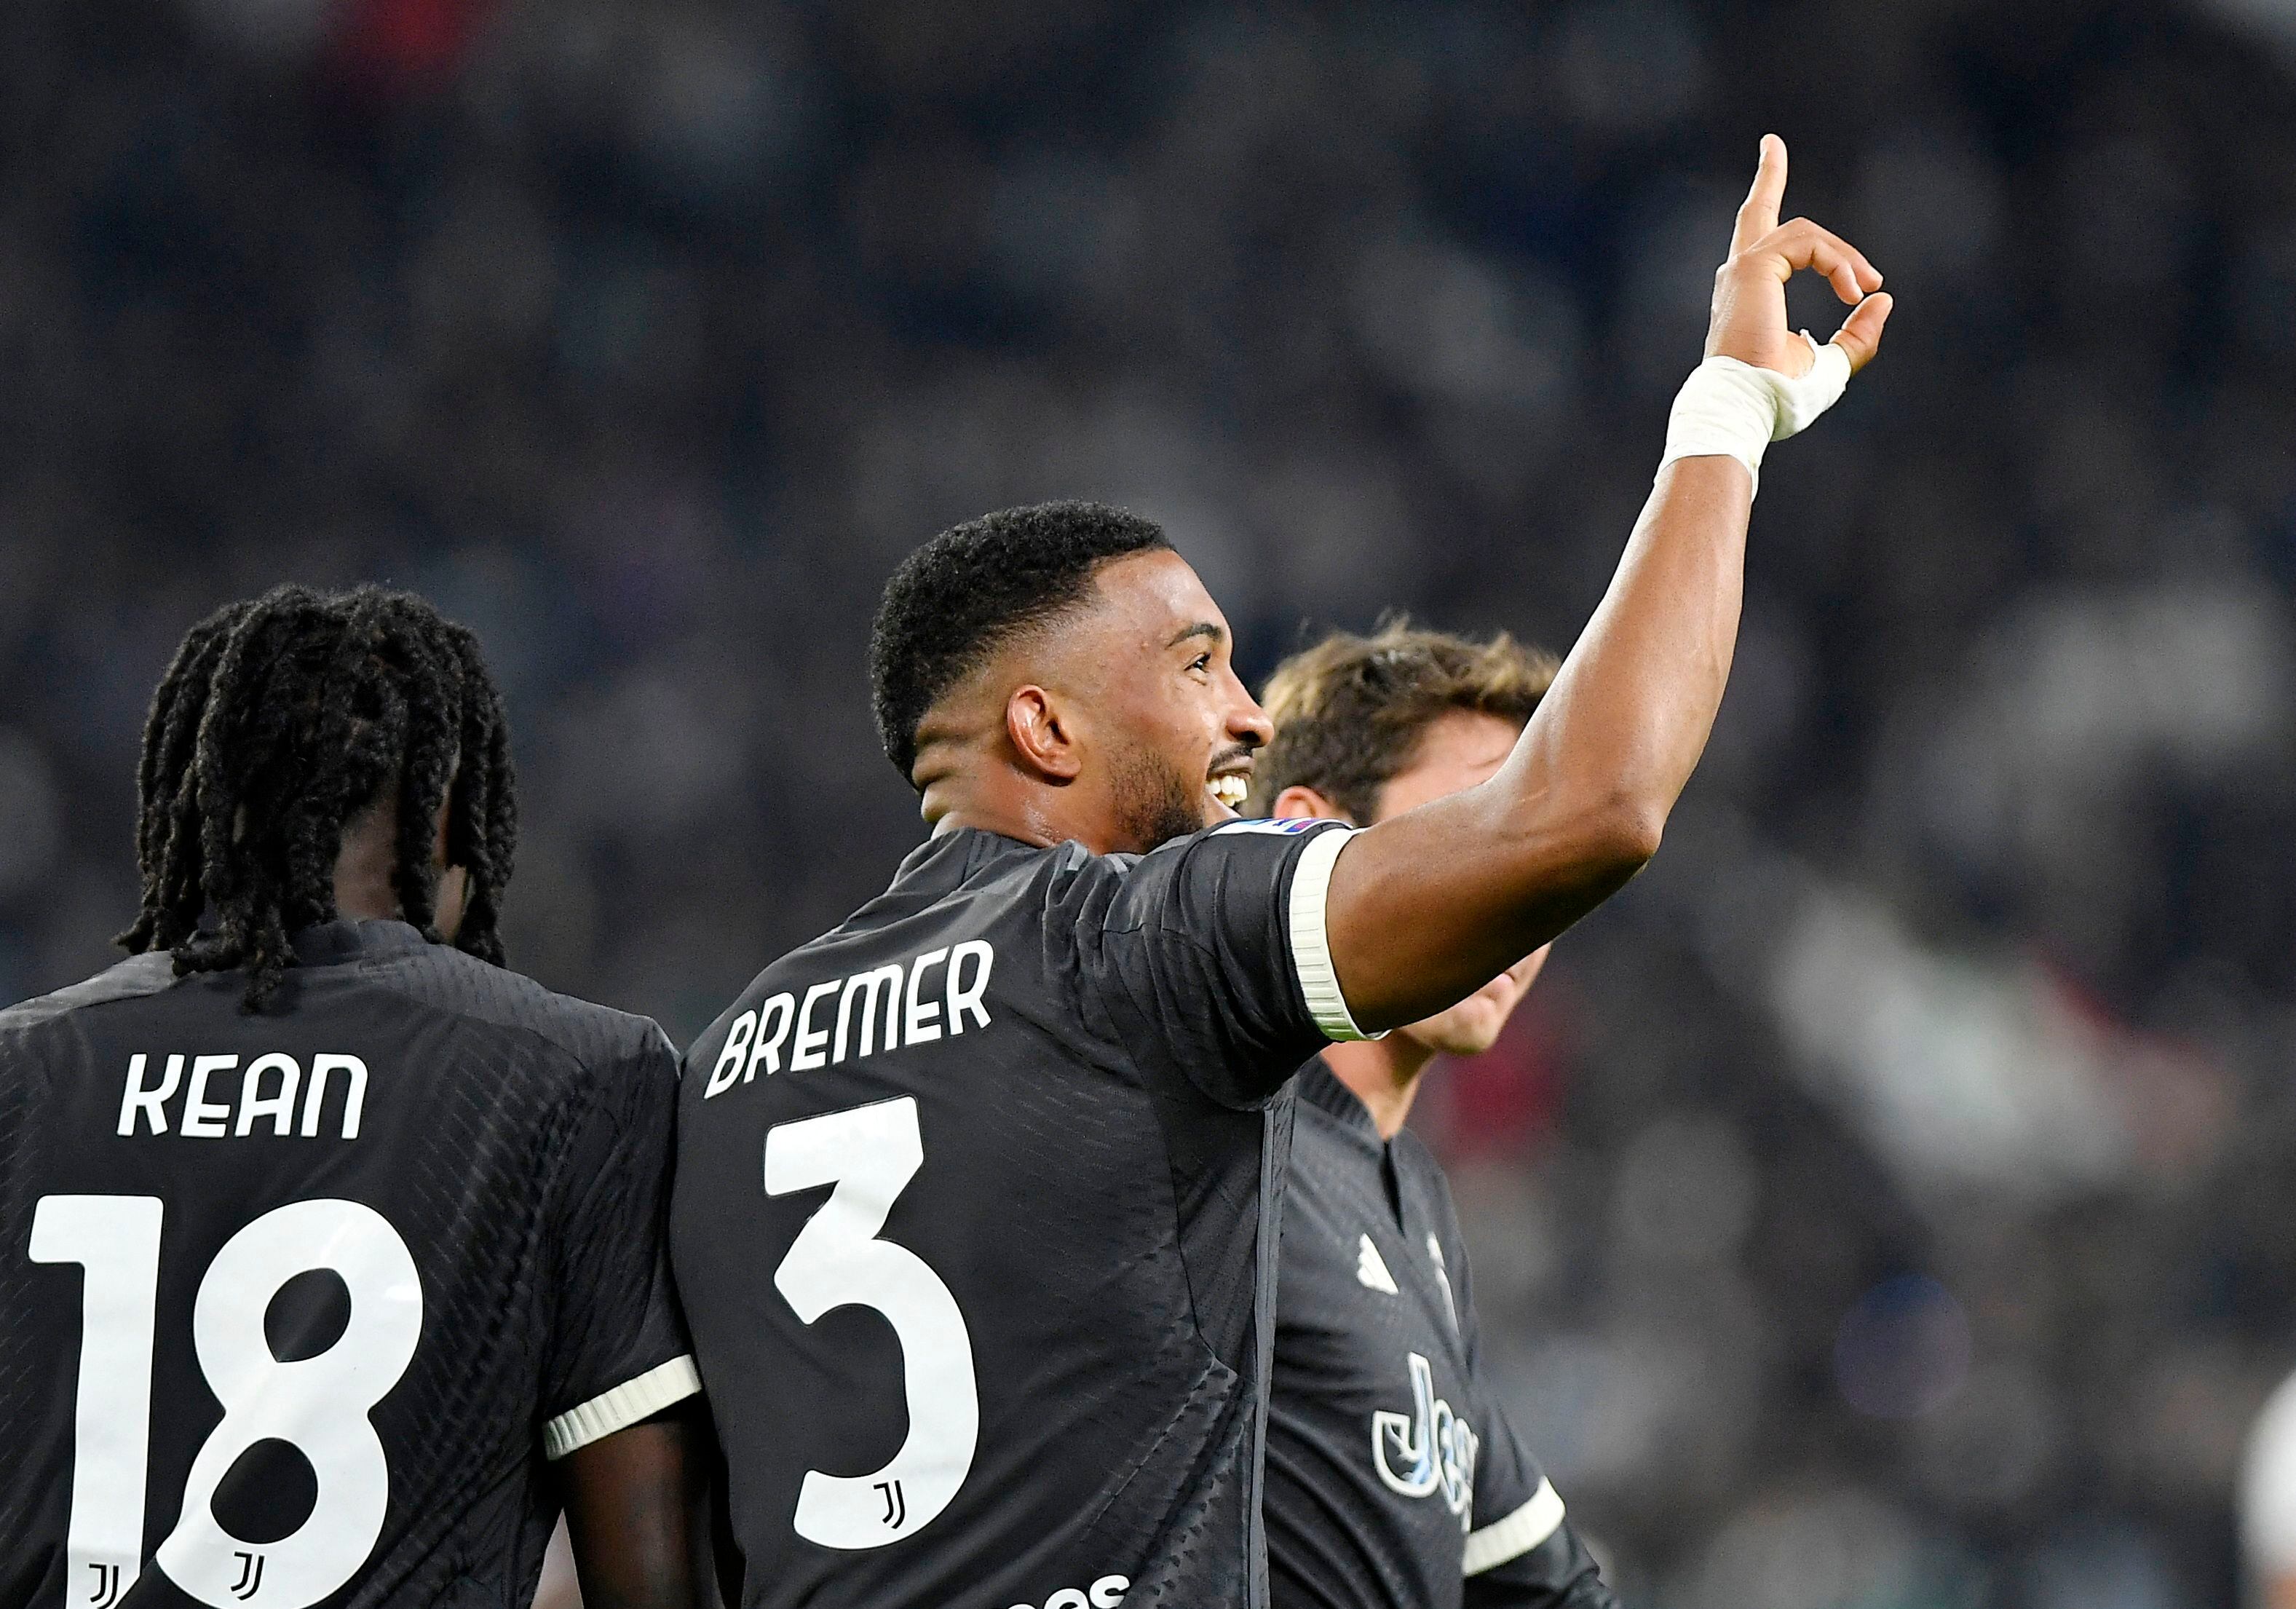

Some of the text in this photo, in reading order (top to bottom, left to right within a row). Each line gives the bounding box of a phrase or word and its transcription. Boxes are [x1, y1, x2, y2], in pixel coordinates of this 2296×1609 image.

[116, 1052, 369, 1139] KEAN
[703, 938, 994, 1100] BREMER
[28, 1194, 424, 1609] 18
[764, 1095, 980, 1550] 3
